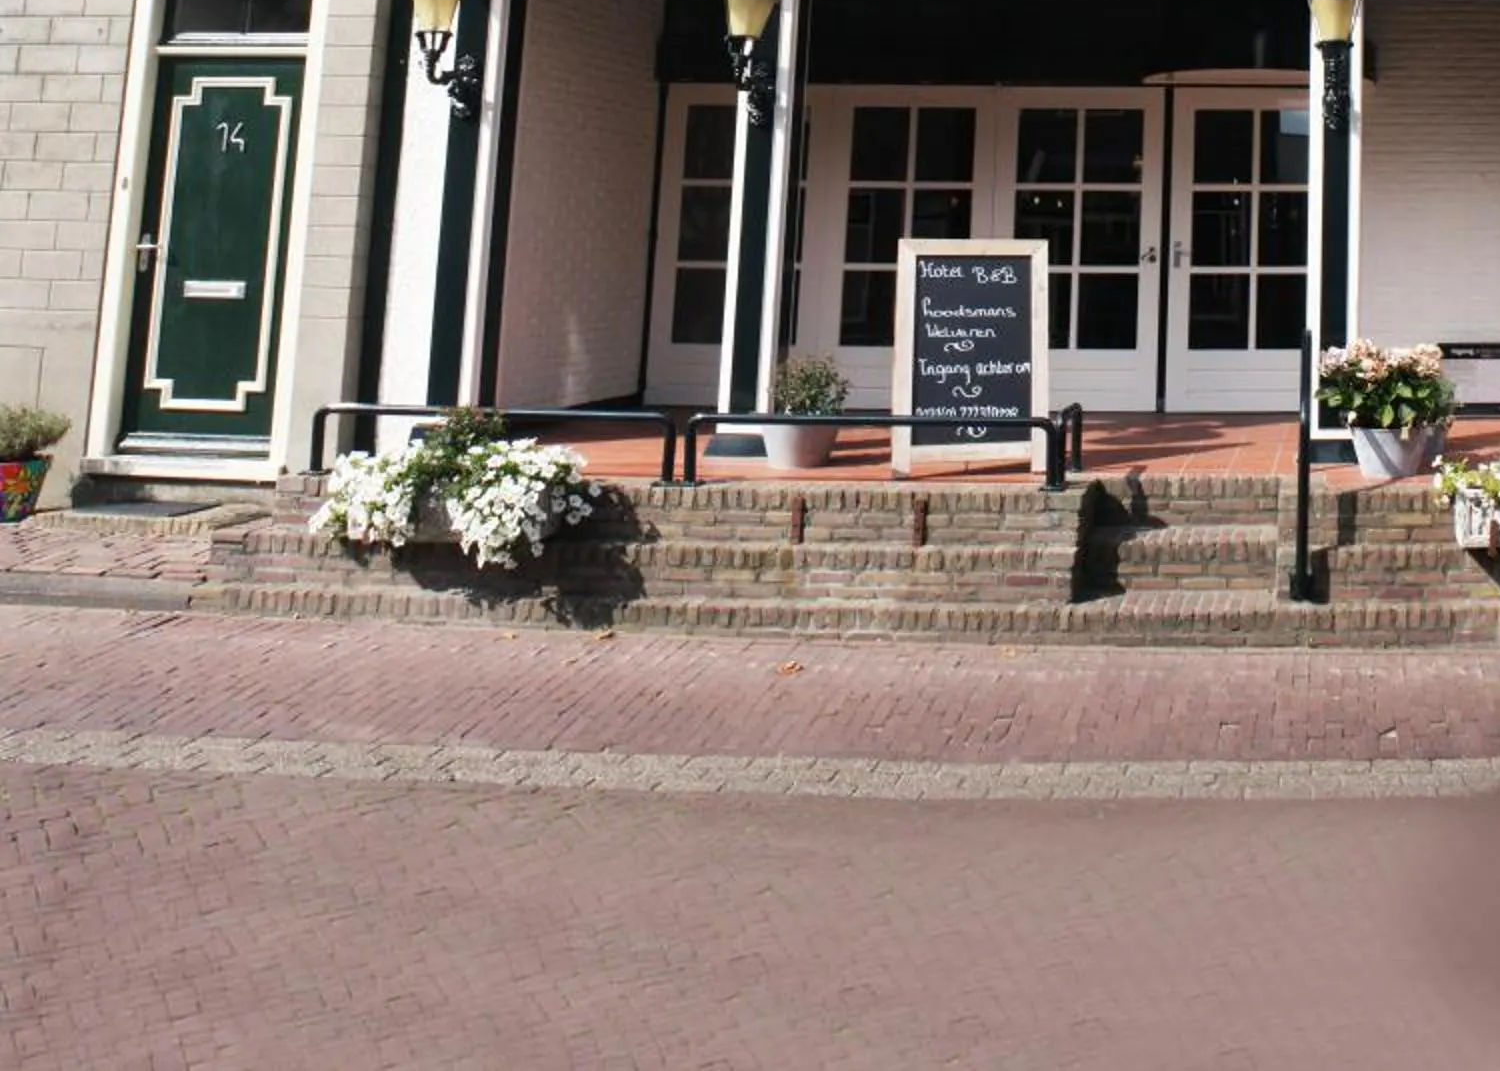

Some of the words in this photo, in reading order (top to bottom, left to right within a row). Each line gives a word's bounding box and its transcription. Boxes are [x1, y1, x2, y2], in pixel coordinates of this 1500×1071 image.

[216, 121, 247, 153] 14
[918, 260, 965, 278] Hotel
[918, 358, 971, 386] Ingang
